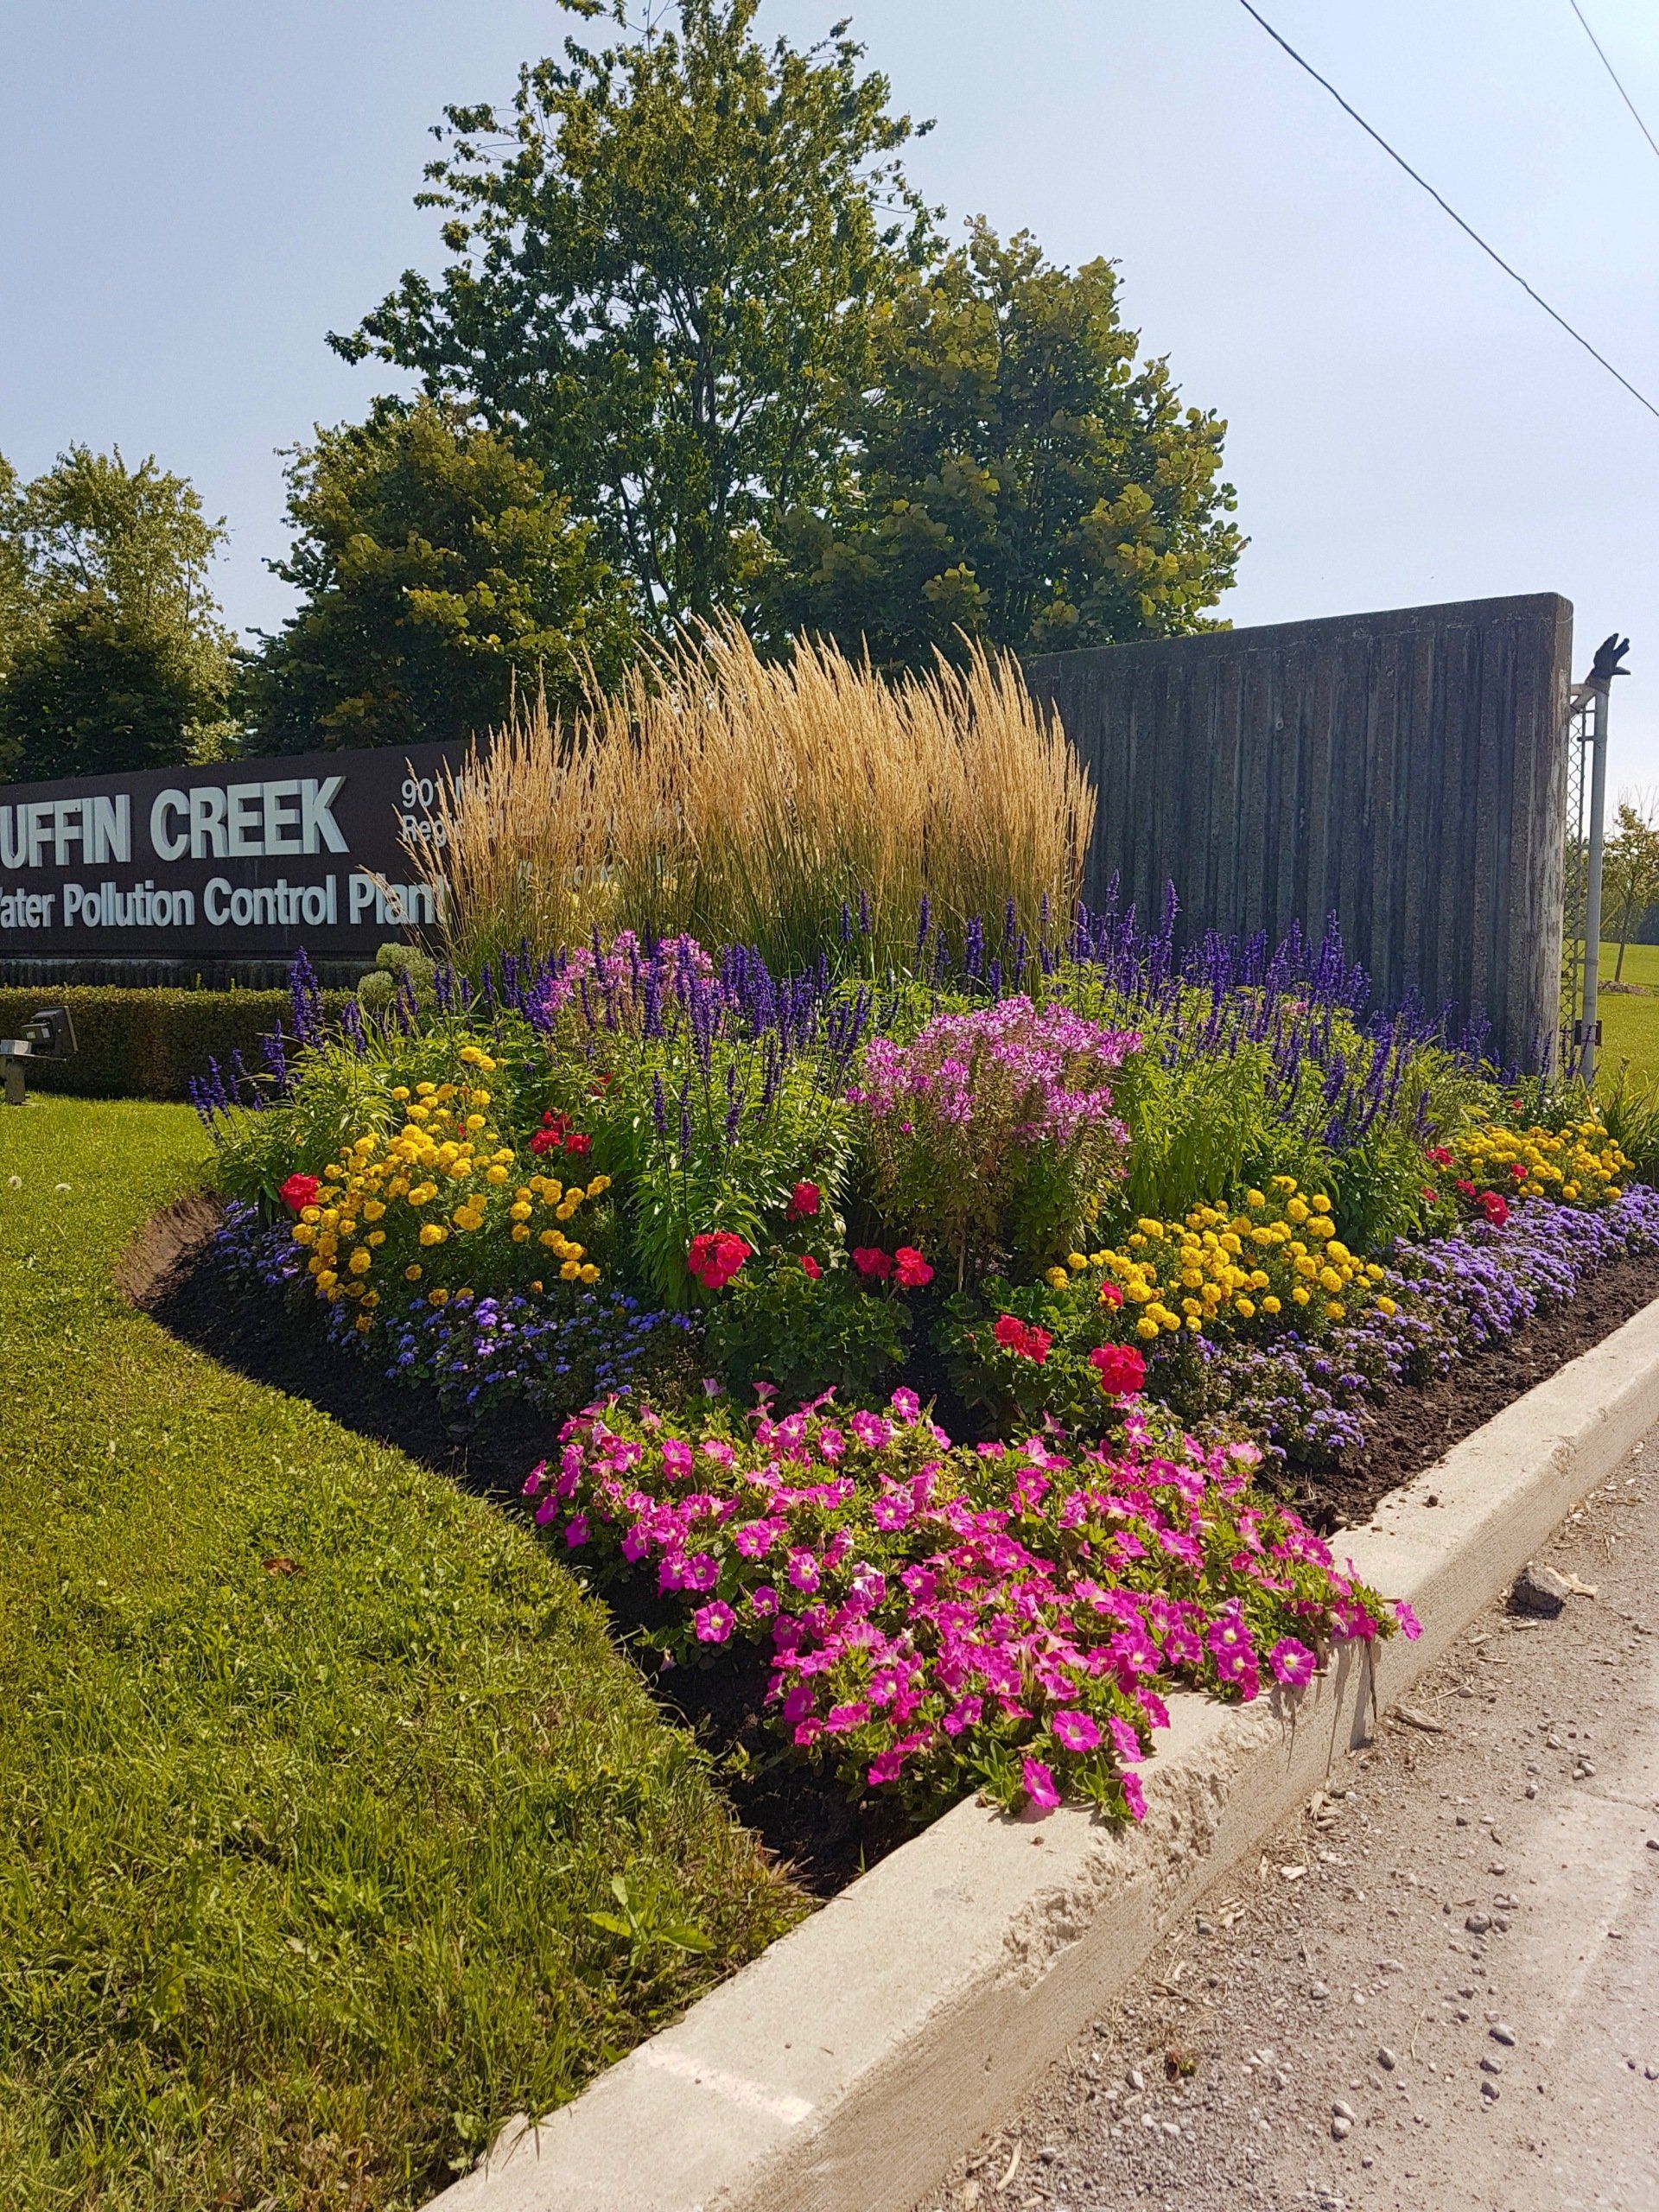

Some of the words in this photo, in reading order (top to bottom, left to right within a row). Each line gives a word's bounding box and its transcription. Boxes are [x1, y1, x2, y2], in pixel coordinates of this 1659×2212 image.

[0, 794, 131, 869] UFFIN
[150, 776, 350, 861] CREEK
[0, 887, 56, 928] ater
[63, 880, 195, 927] Pollution
[203, 874, 338, 926] Control
